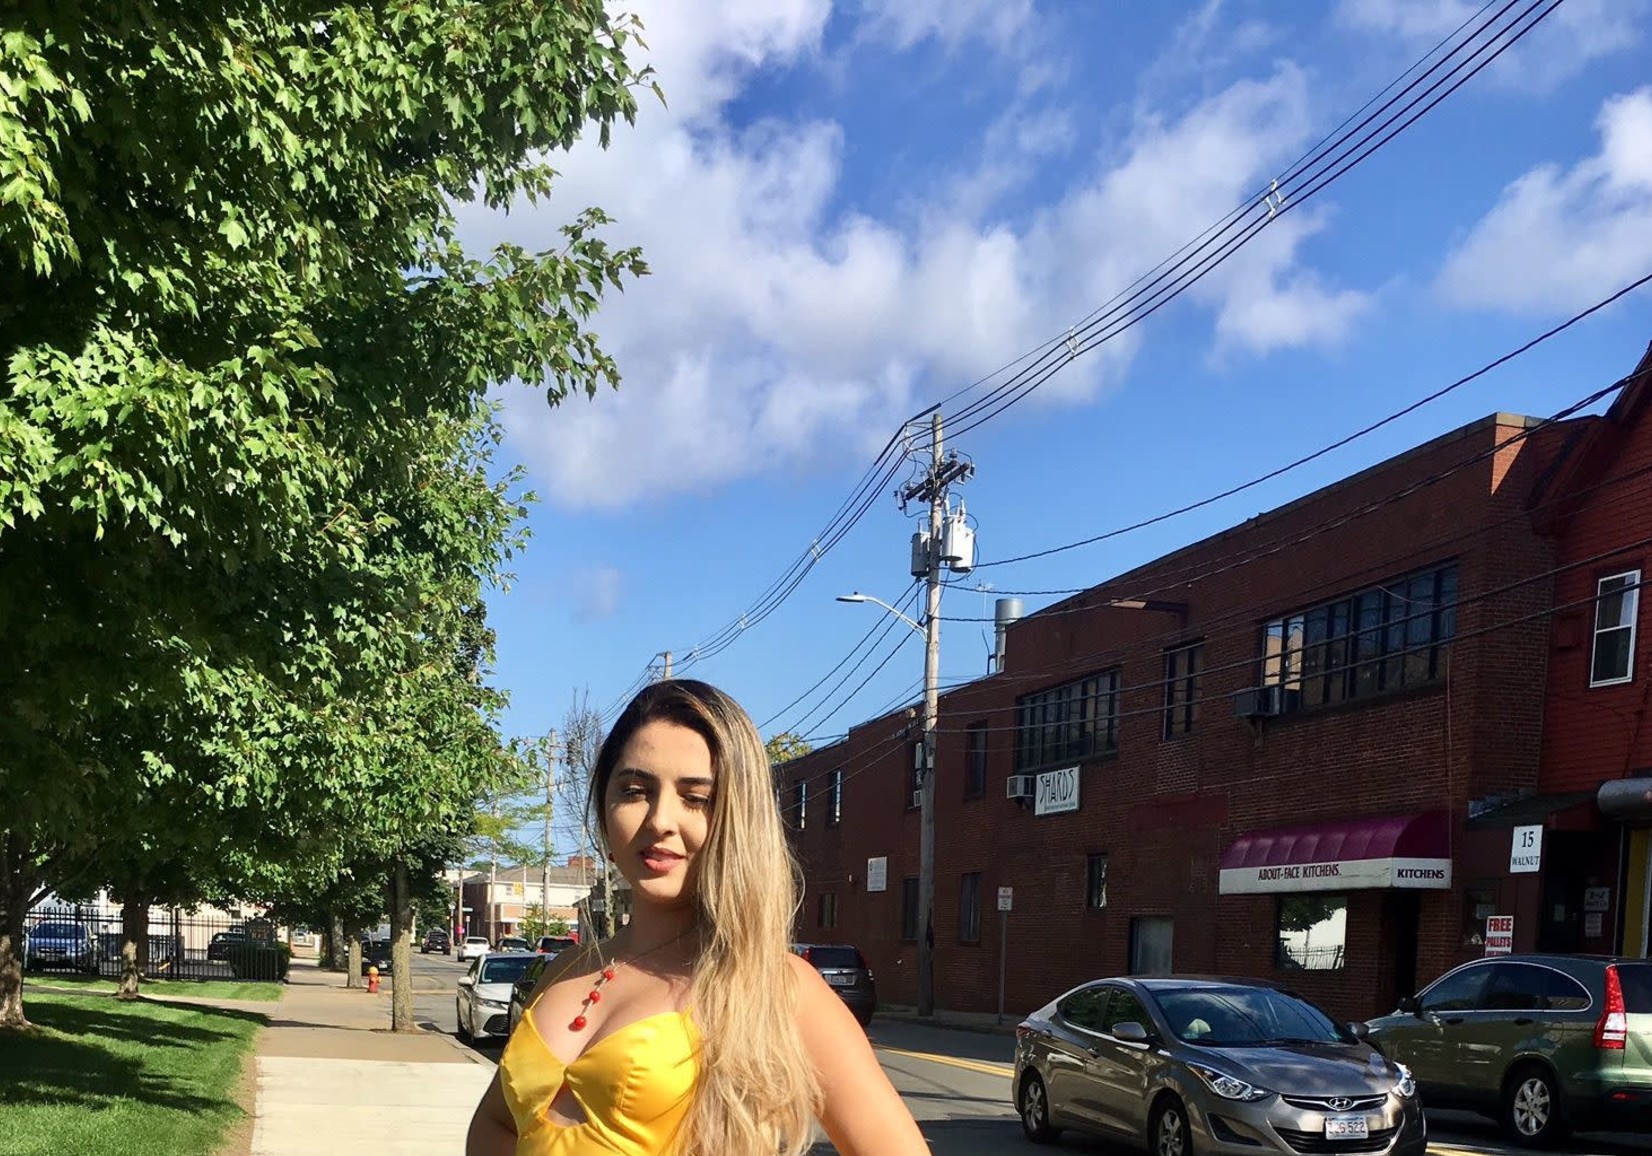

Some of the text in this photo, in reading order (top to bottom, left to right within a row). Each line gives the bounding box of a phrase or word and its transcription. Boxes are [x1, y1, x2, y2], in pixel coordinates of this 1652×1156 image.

[1040, 769, 1074, 804] SHARDS
[1522, 831, 1534, 847] 15
[1512, 856, 1540, 866] WALNUT
[1258, 866, 1299, 881] ABOUT-FACE
[1397, 868, 1444, 880] KITCHENS
[1488, 918, 1512, 932] FREE
